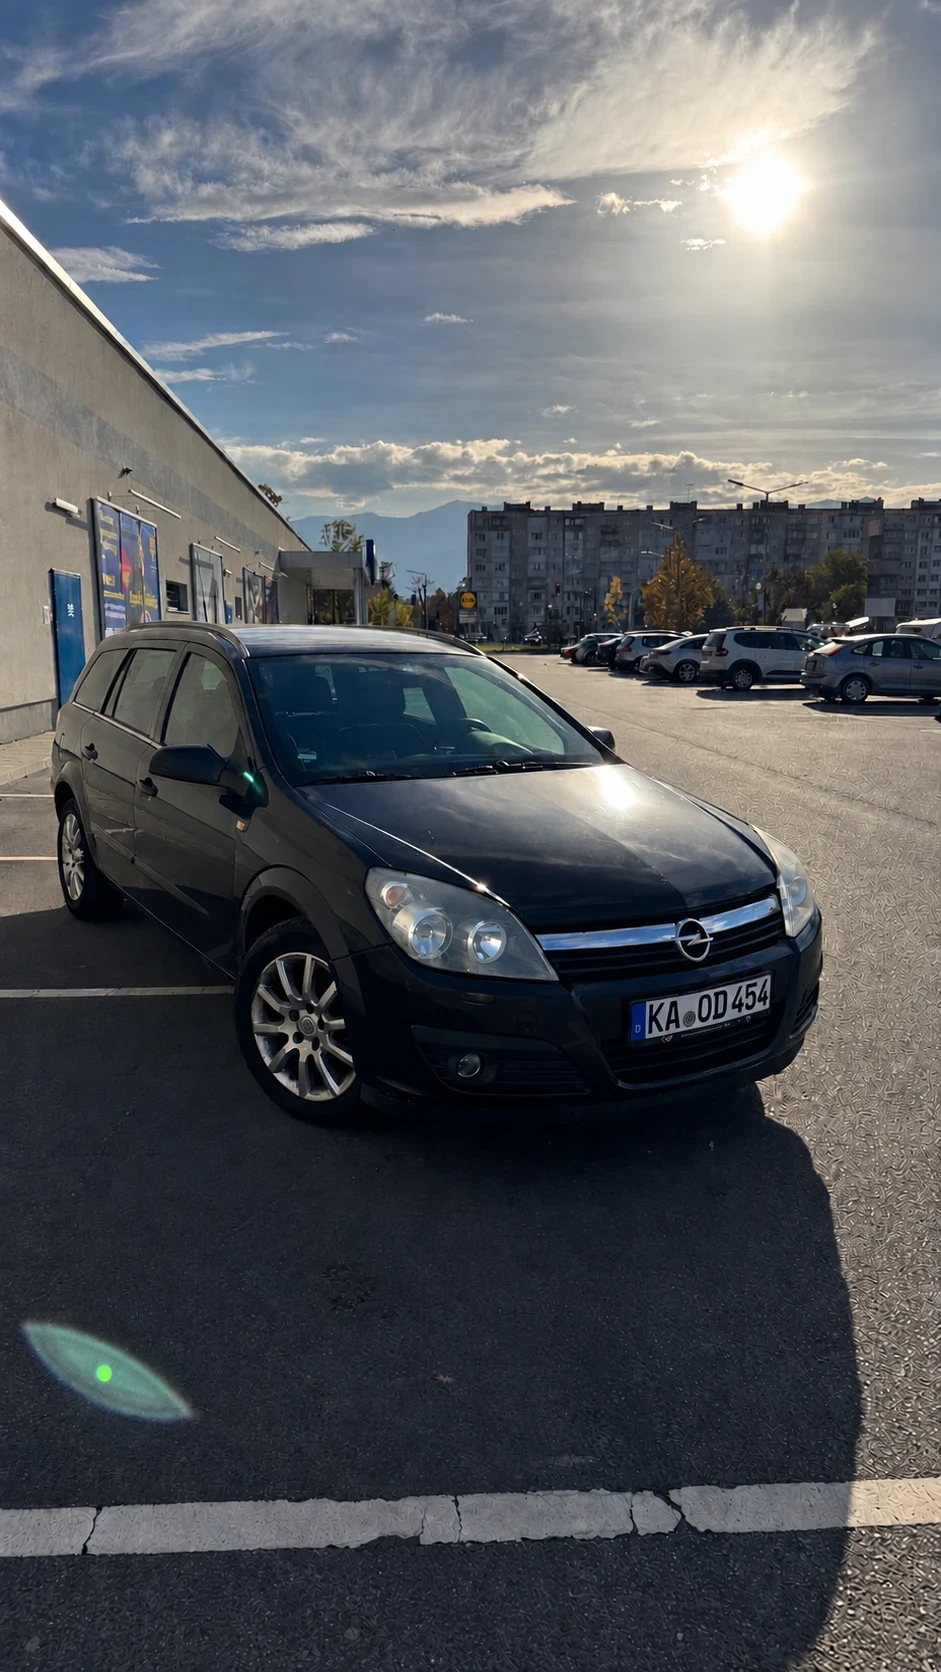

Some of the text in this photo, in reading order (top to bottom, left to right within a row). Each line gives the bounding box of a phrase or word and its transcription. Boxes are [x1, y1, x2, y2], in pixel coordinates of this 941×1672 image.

[635, 1024, 641, 1033] D
[648, 1000, 680, 1034] KA
[698, 990, 727, 1022] OD
[731, 979, 768, 1013] 454
